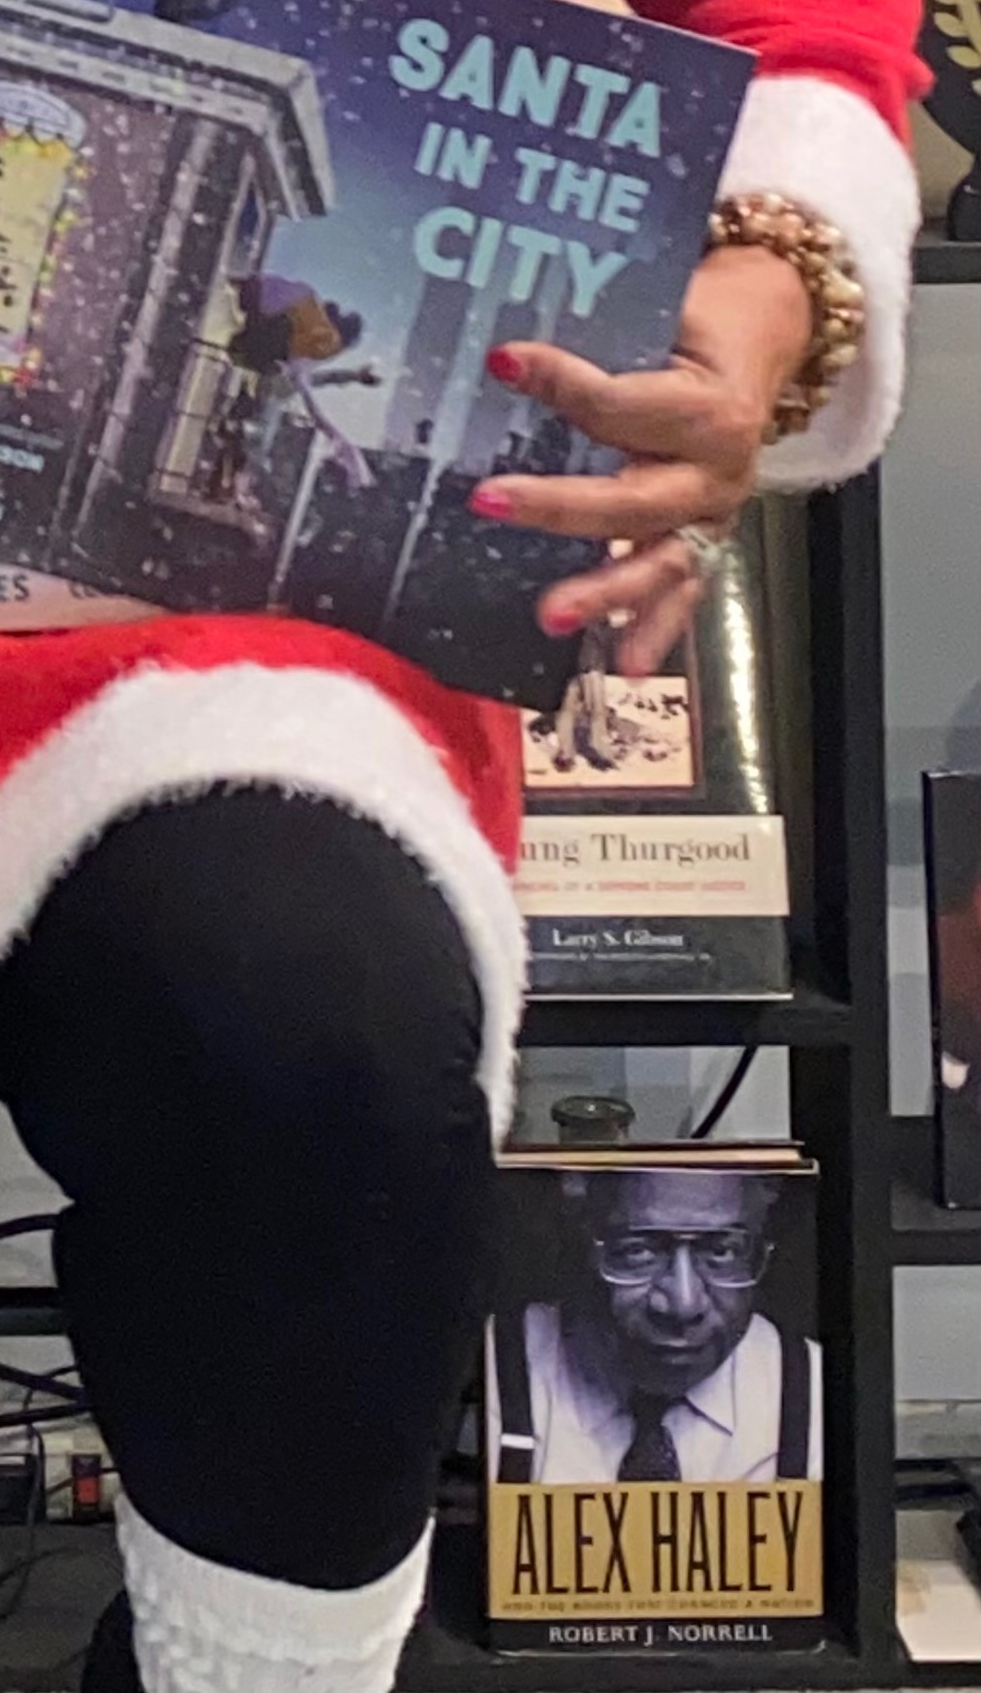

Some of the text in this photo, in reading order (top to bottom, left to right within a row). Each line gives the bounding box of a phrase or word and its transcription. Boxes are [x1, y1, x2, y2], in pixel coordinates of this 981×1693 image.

[389, 18, 662, 158] SANTA
[414, 122, 651, 233] IN THE
[413, 206, 627, 318] CITY
[520, 833, 751, 868] ung Thurgood
[511, 1490, 804, 1595] ALEX HALEY
[548, 1625, 637, 1644] ROBERT
[667, 1623, 774, 1643] NORRELL
